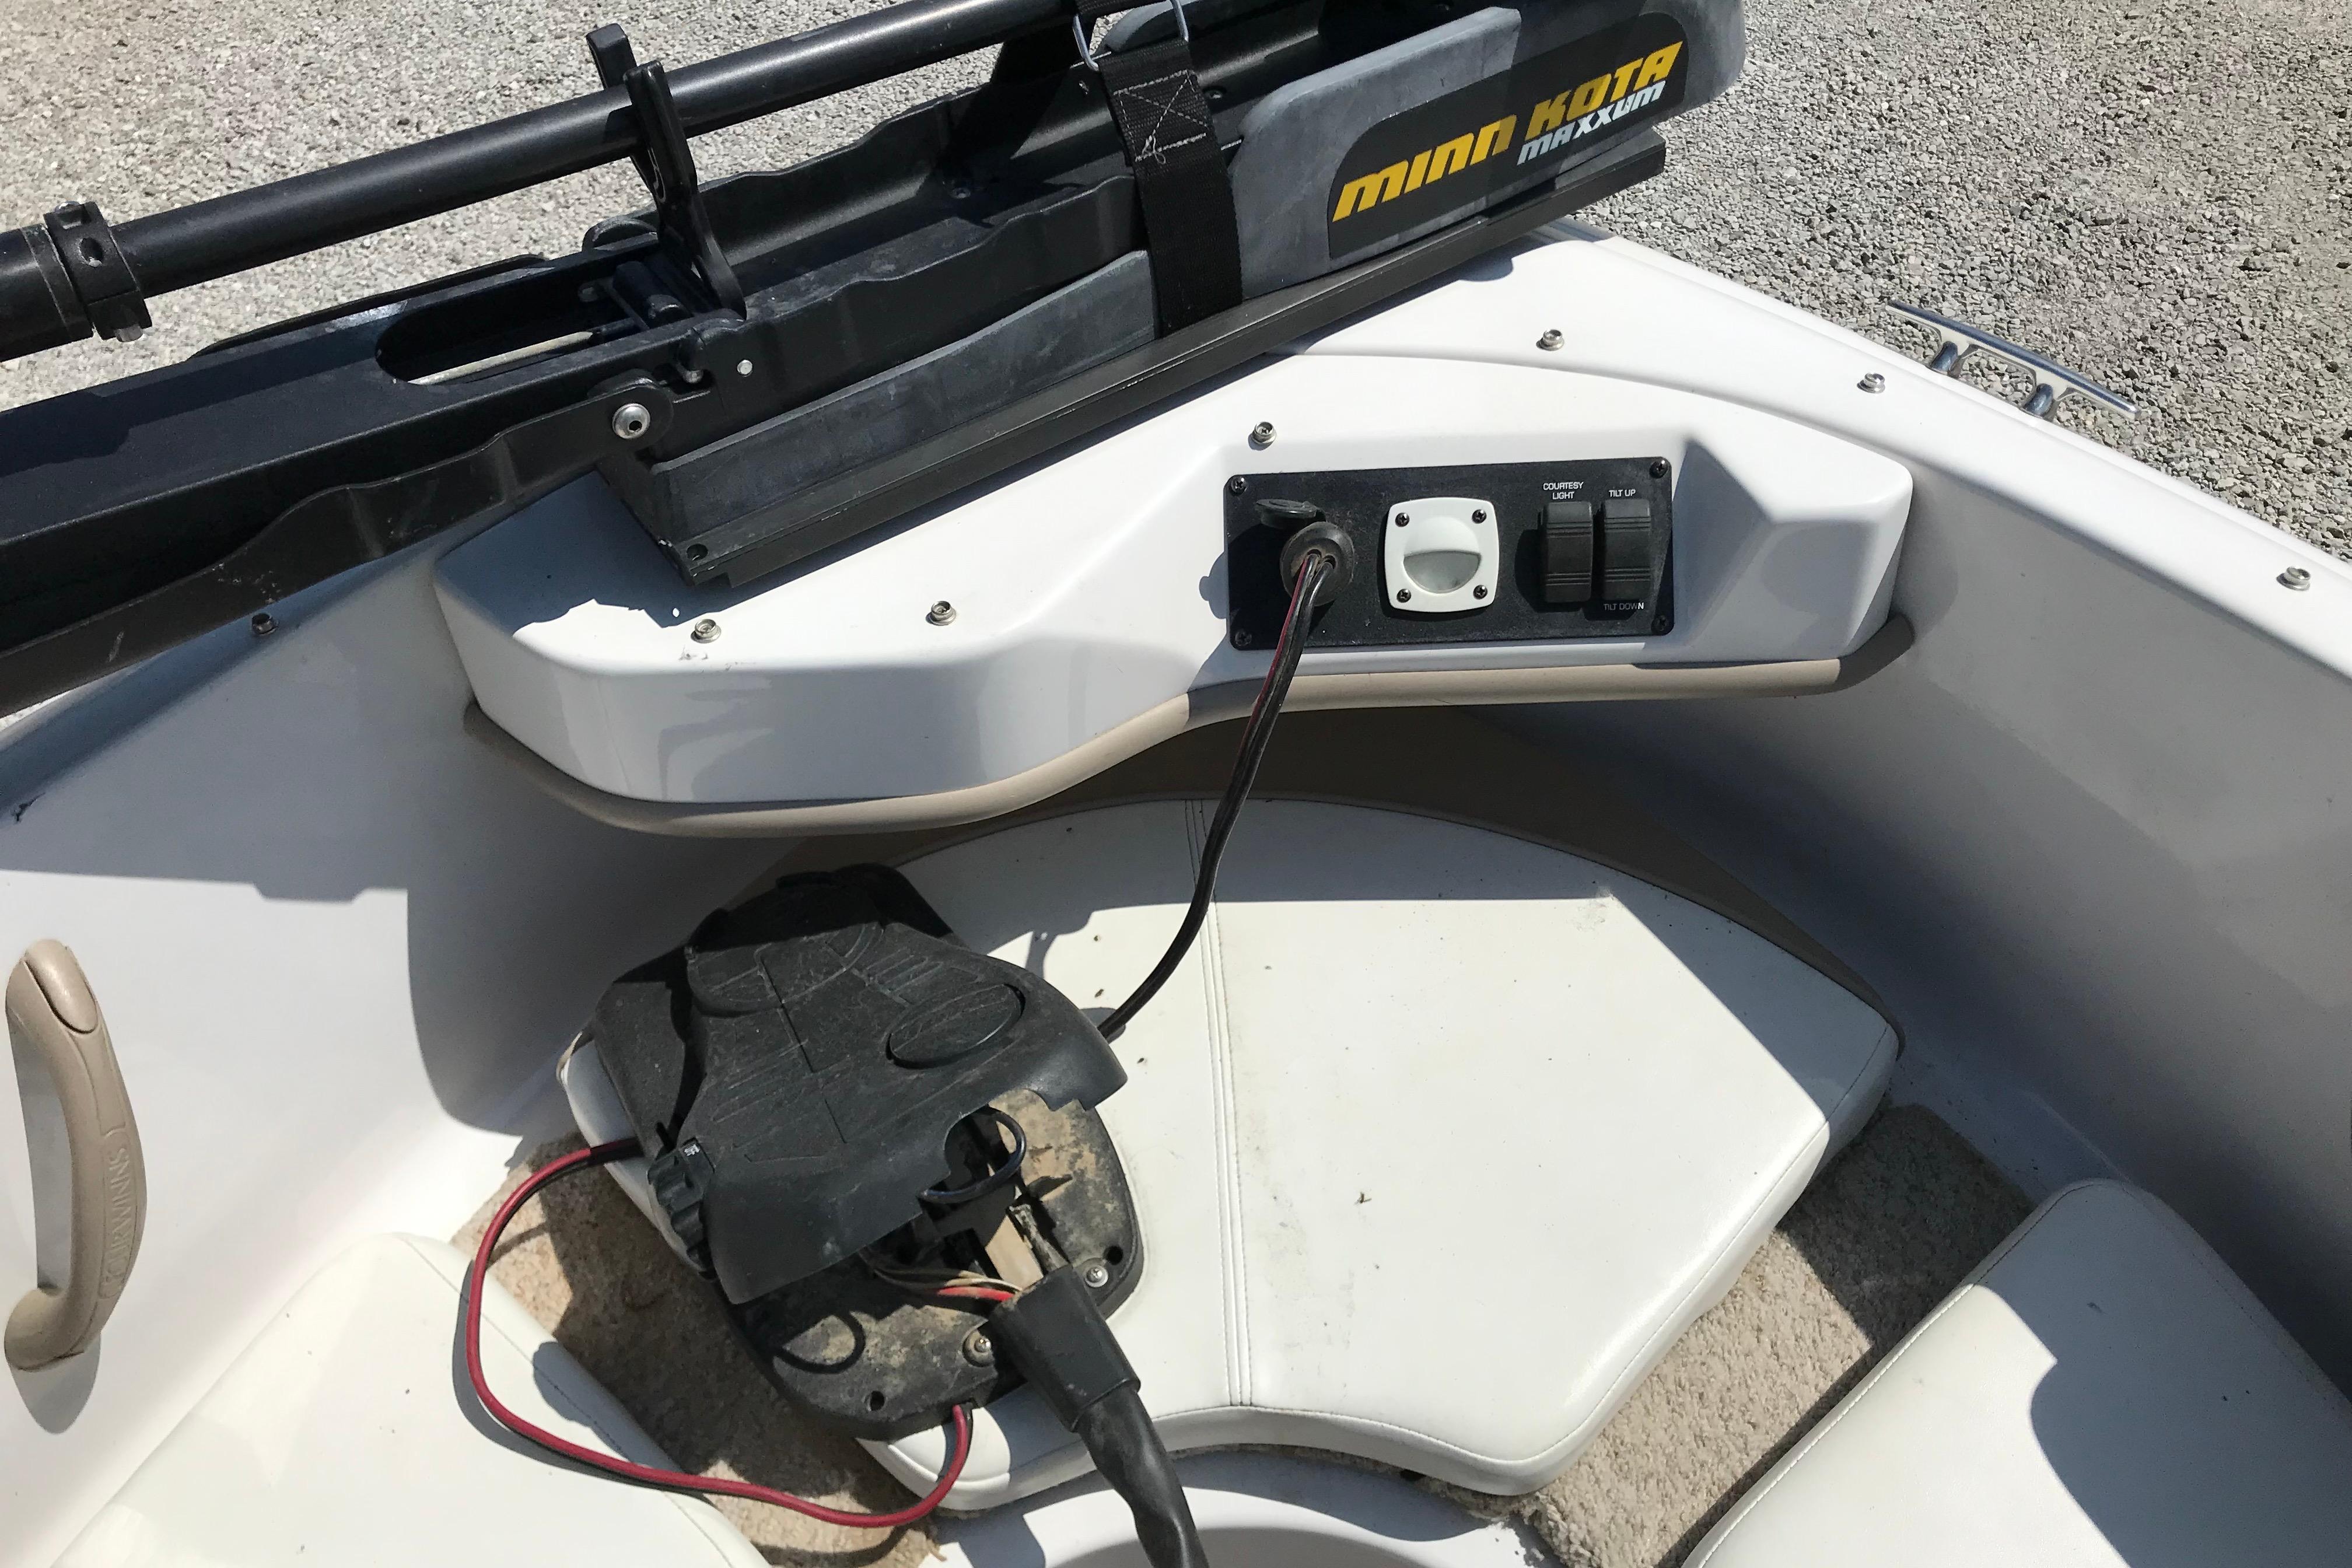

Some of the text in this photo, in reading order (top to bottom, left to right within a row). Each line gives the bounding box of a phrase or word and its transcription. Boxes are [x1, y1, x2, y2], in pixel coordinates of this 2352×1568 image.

[1524, 40, 1684, 141] KOTA
[1517, 80, 1666, 166] MAXXUM
[1543, 481, 1584, 491] COURTESY
[1552, 491, 1575, 500] LIGHT
[1608, 489, 1636, 498] TILT UP
[1619, 602, 1644, 611] DOWN
